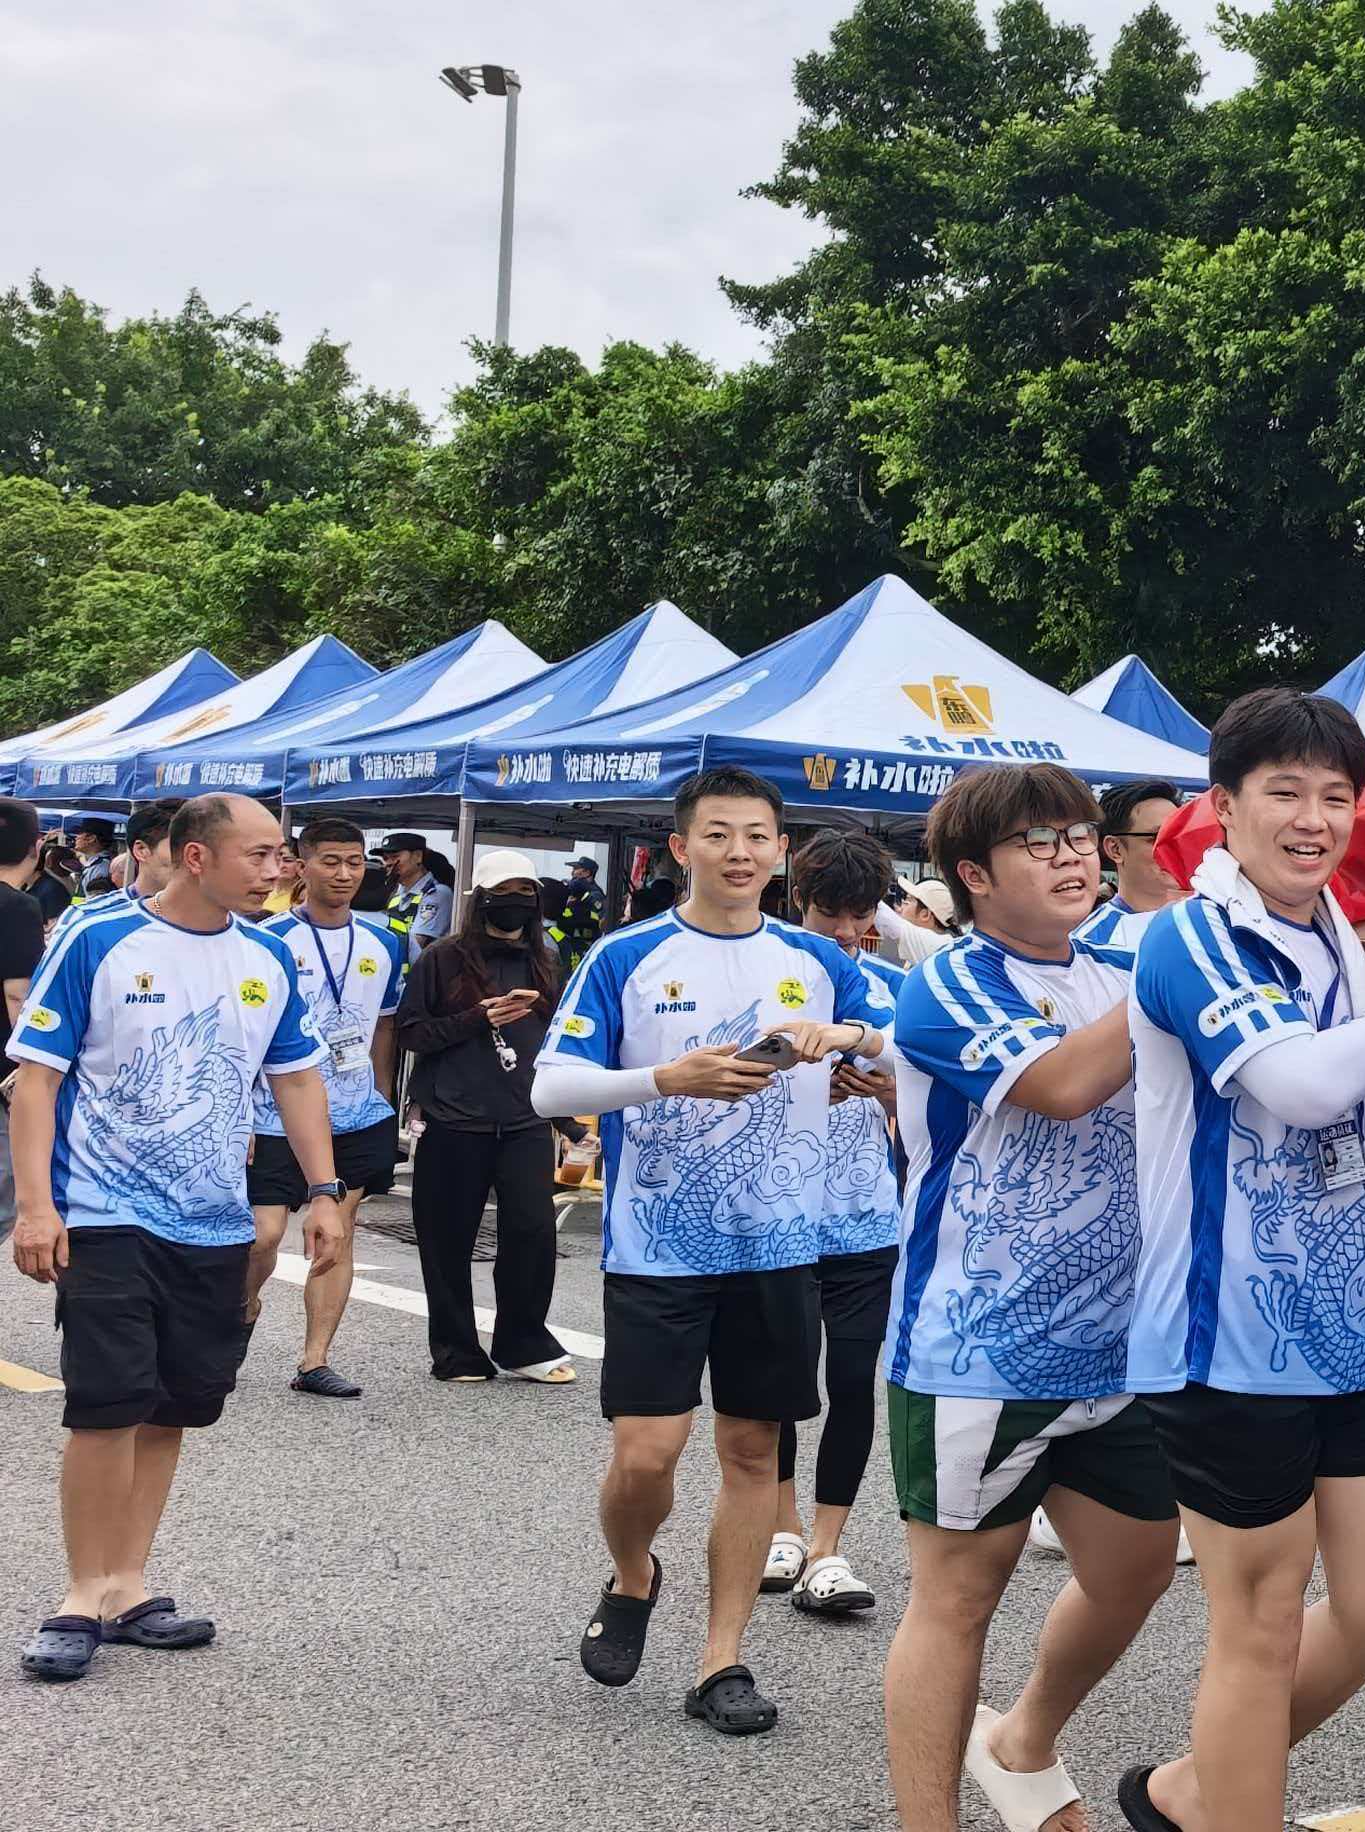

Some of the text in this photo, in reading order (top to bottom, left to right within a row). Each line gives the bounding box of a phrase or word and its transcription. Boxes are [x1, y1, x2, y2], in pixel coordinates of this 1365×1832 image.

[509, 751, 662, 784] 补水啦 快速补充电解质
